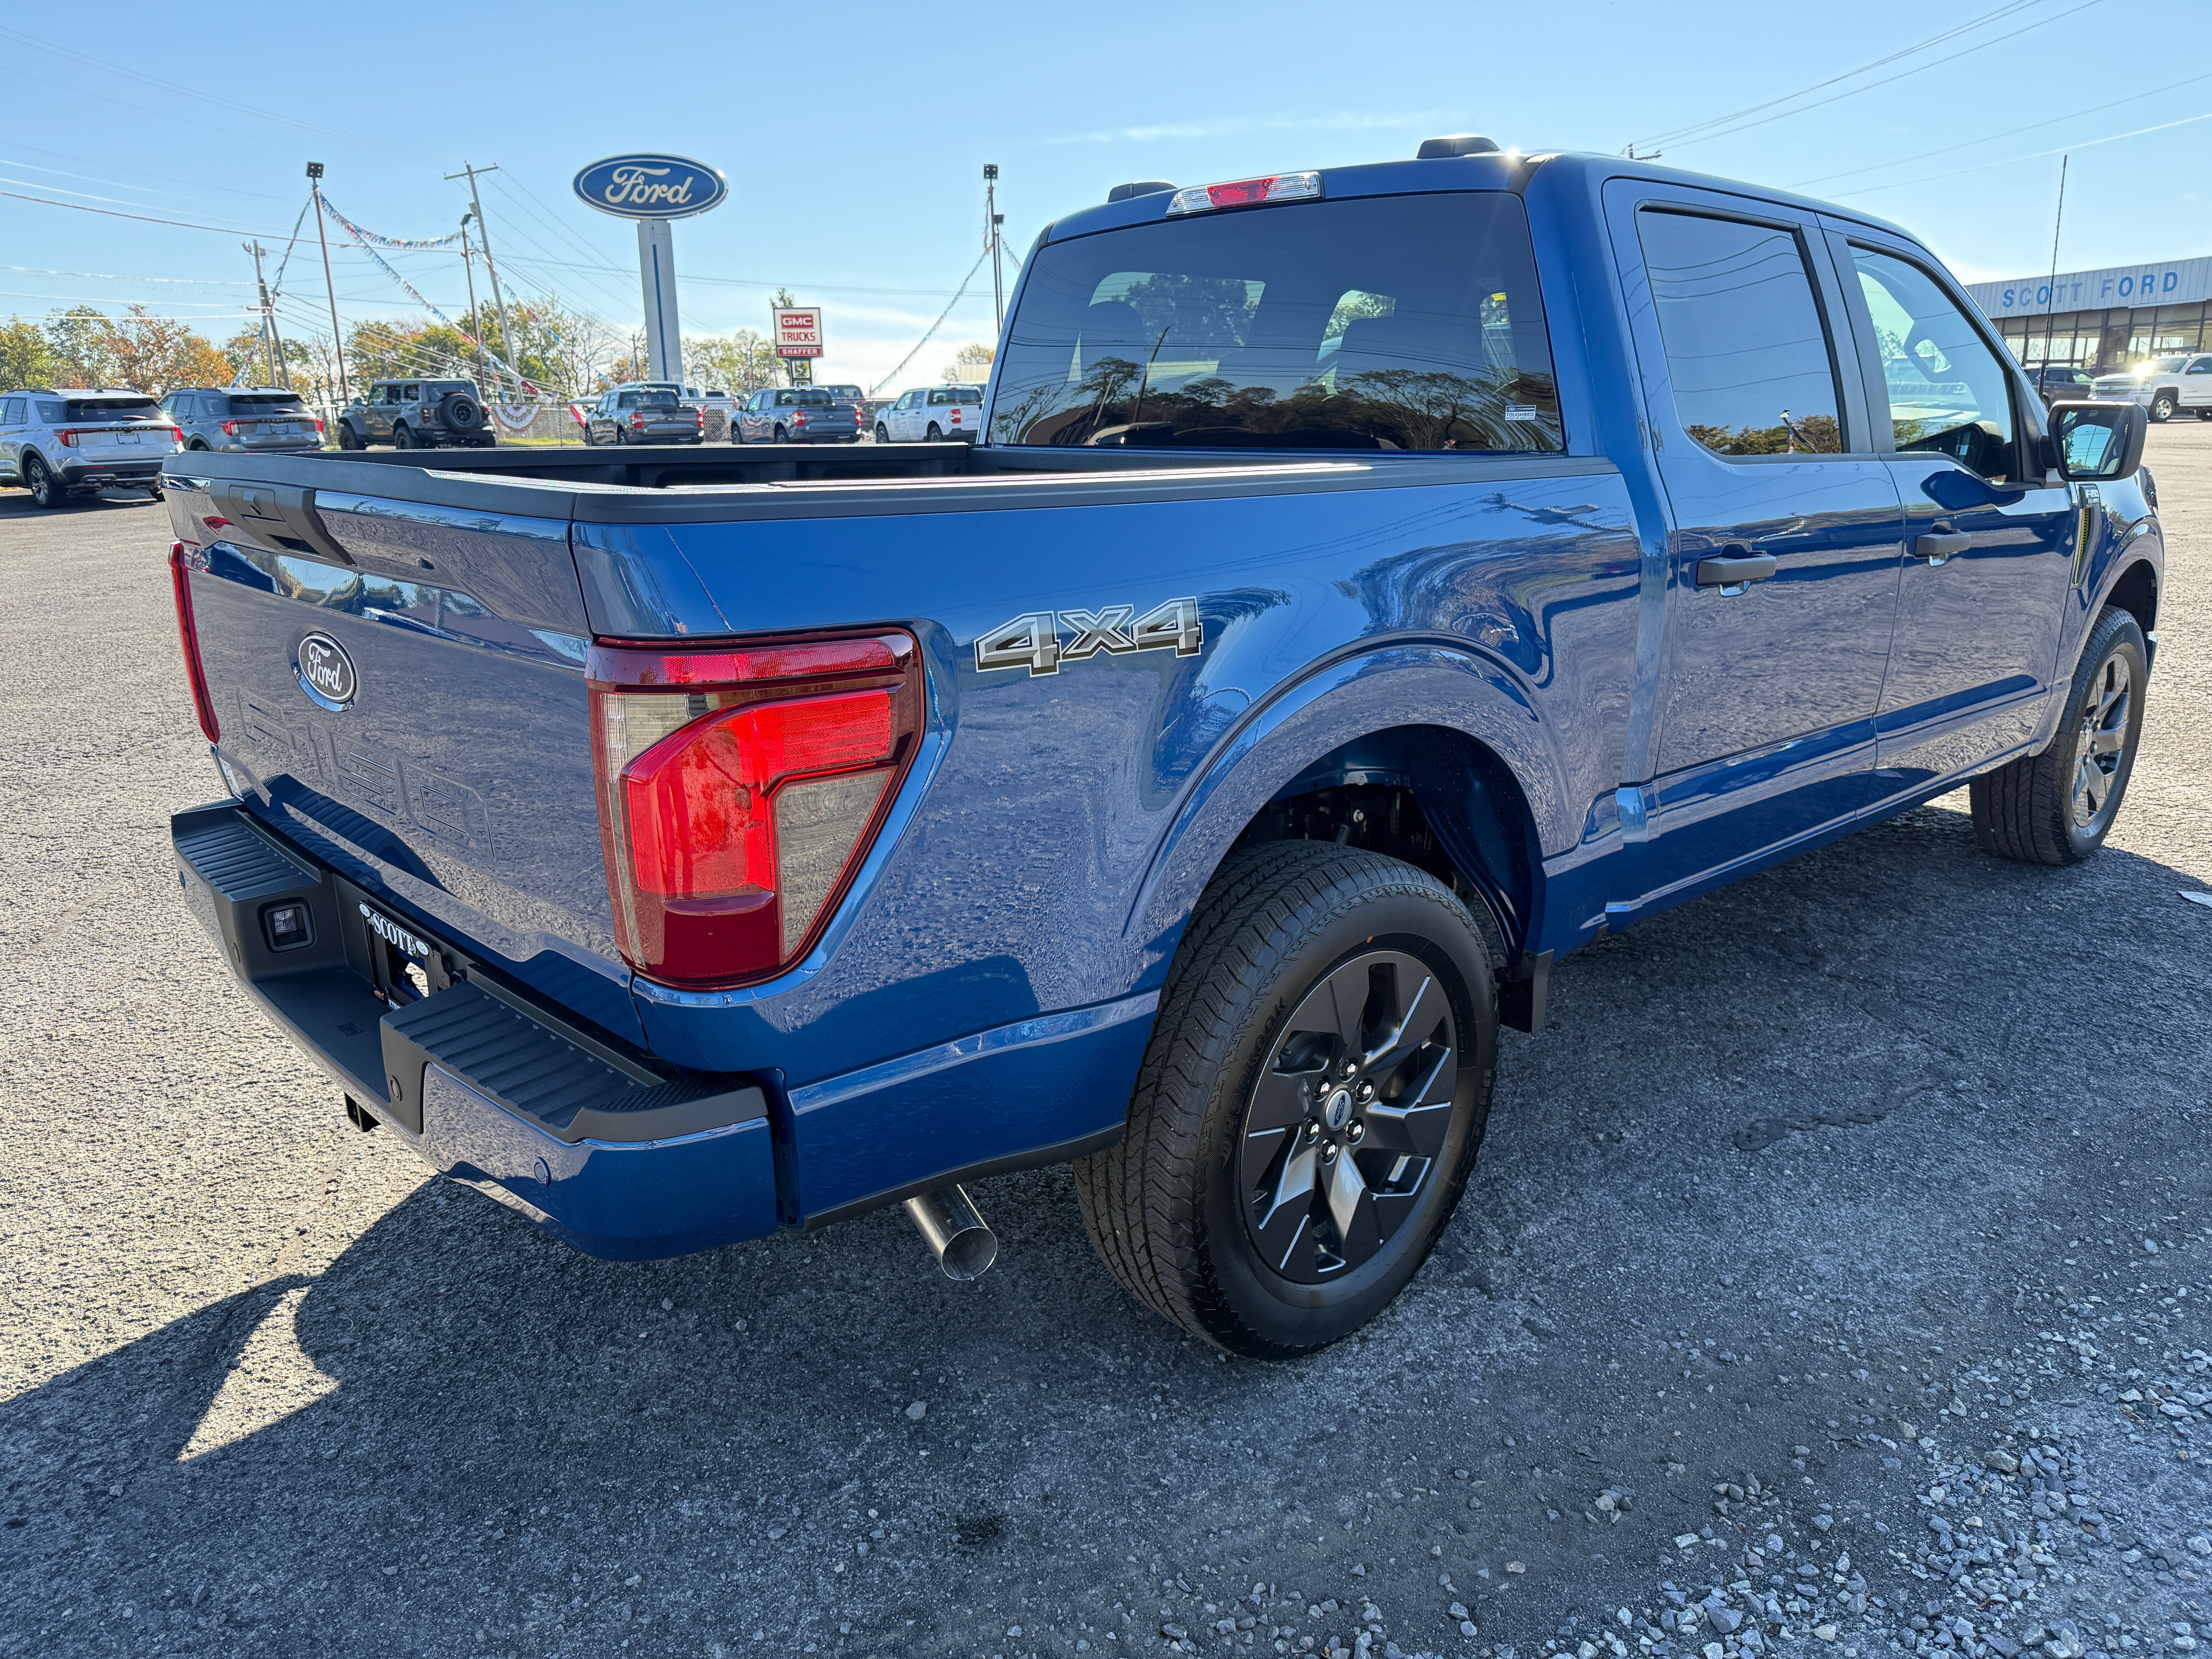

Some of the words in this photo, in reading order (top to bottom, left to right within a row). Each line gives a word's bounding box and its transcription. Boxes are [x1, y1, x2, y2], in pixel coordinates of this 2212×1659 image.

[605, 166, 694, 204] Ford
[2002, 282, 2083, 308] SCOTT
[2100, 271, 2178, 299] FORD
[781, 332, 816, 341] TRUCKS
[307, 642, 342, 692] Ford
[373, 913, 414, 956] SCOTT
[1335, 1099, 1345, 1121] Ford
